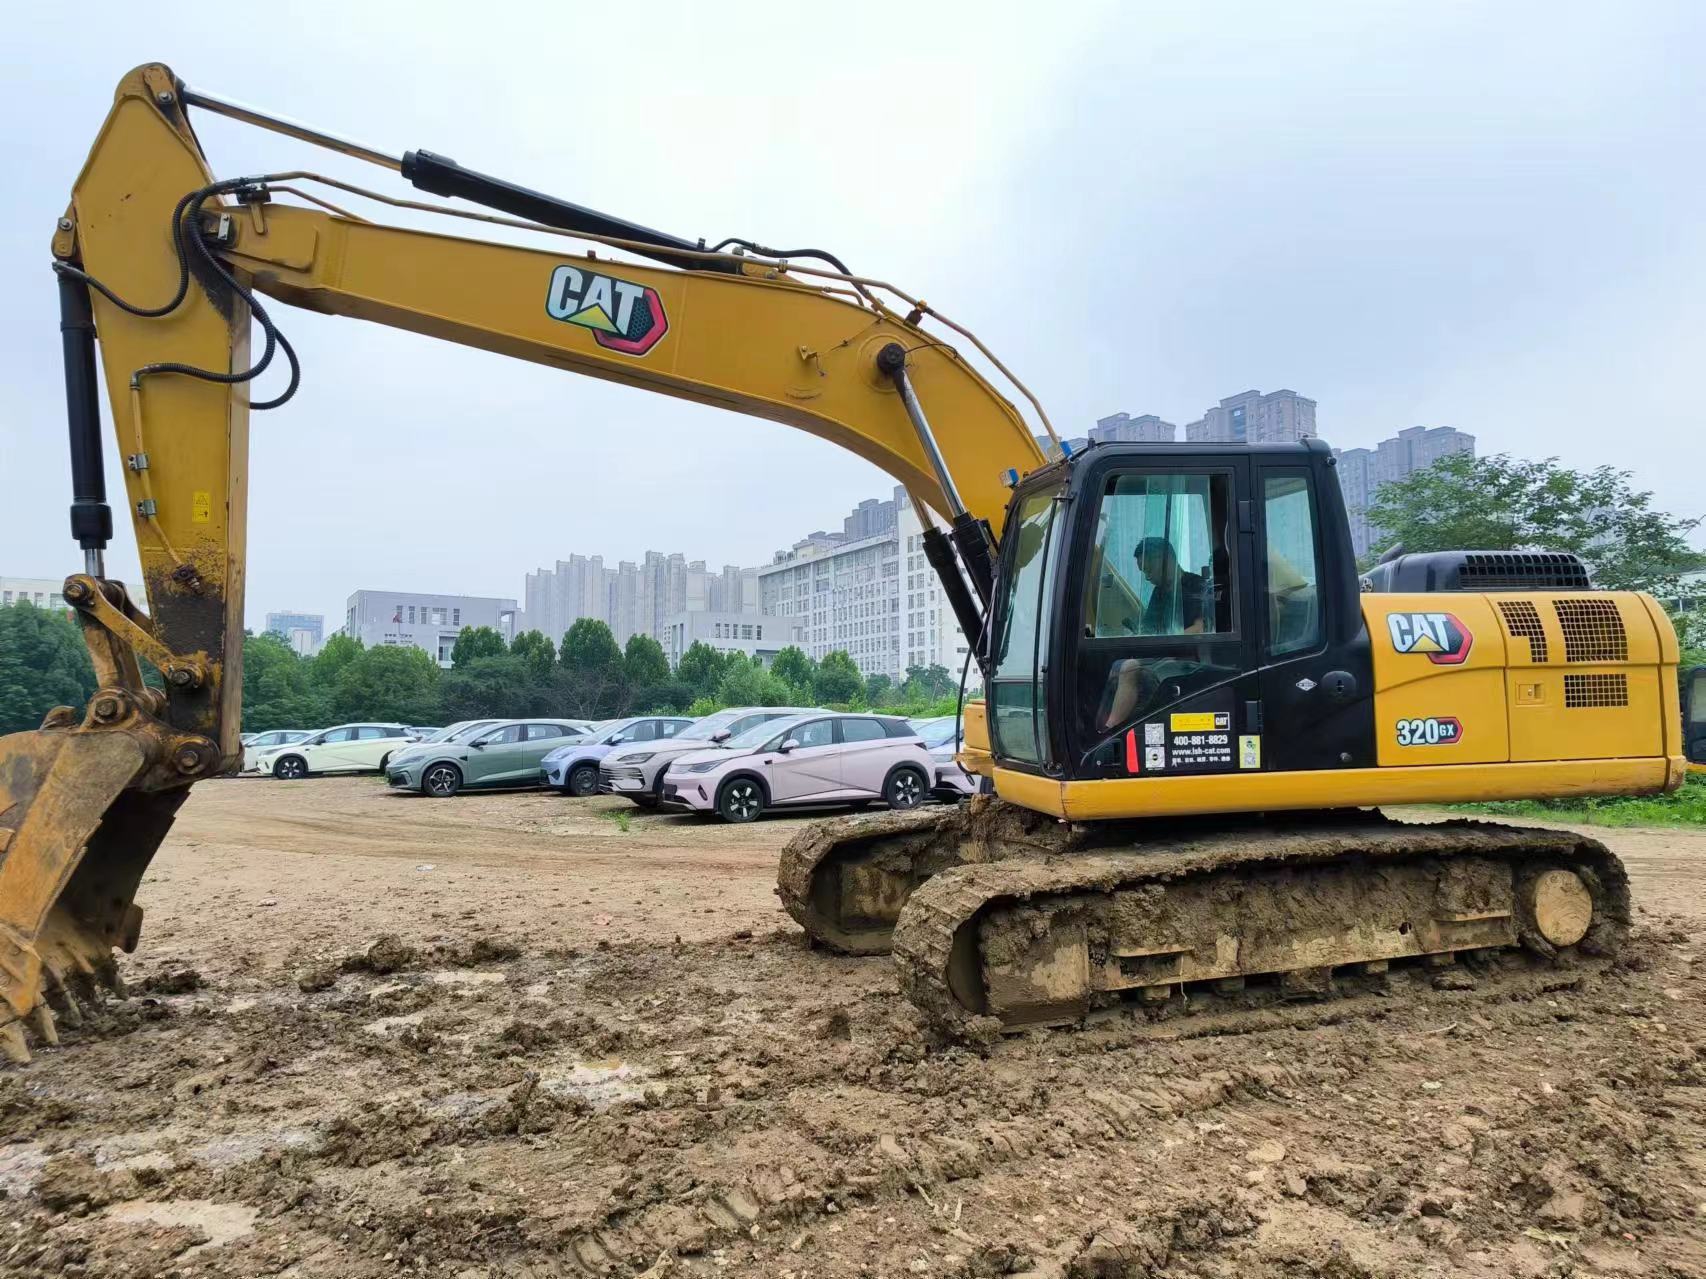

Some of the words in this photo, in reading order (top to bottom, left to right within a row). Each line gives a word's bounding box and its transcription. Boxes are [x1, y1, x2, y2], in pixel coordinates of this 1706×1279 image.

[548, 266, 644, 336] CAT
[1387, 613, 1450, 652] CAT
[1173, 735, 1228, 746] 400-881-8829
[1397, 718, 1439, 745] 320
[1439, 724, 1454, 736] GX
